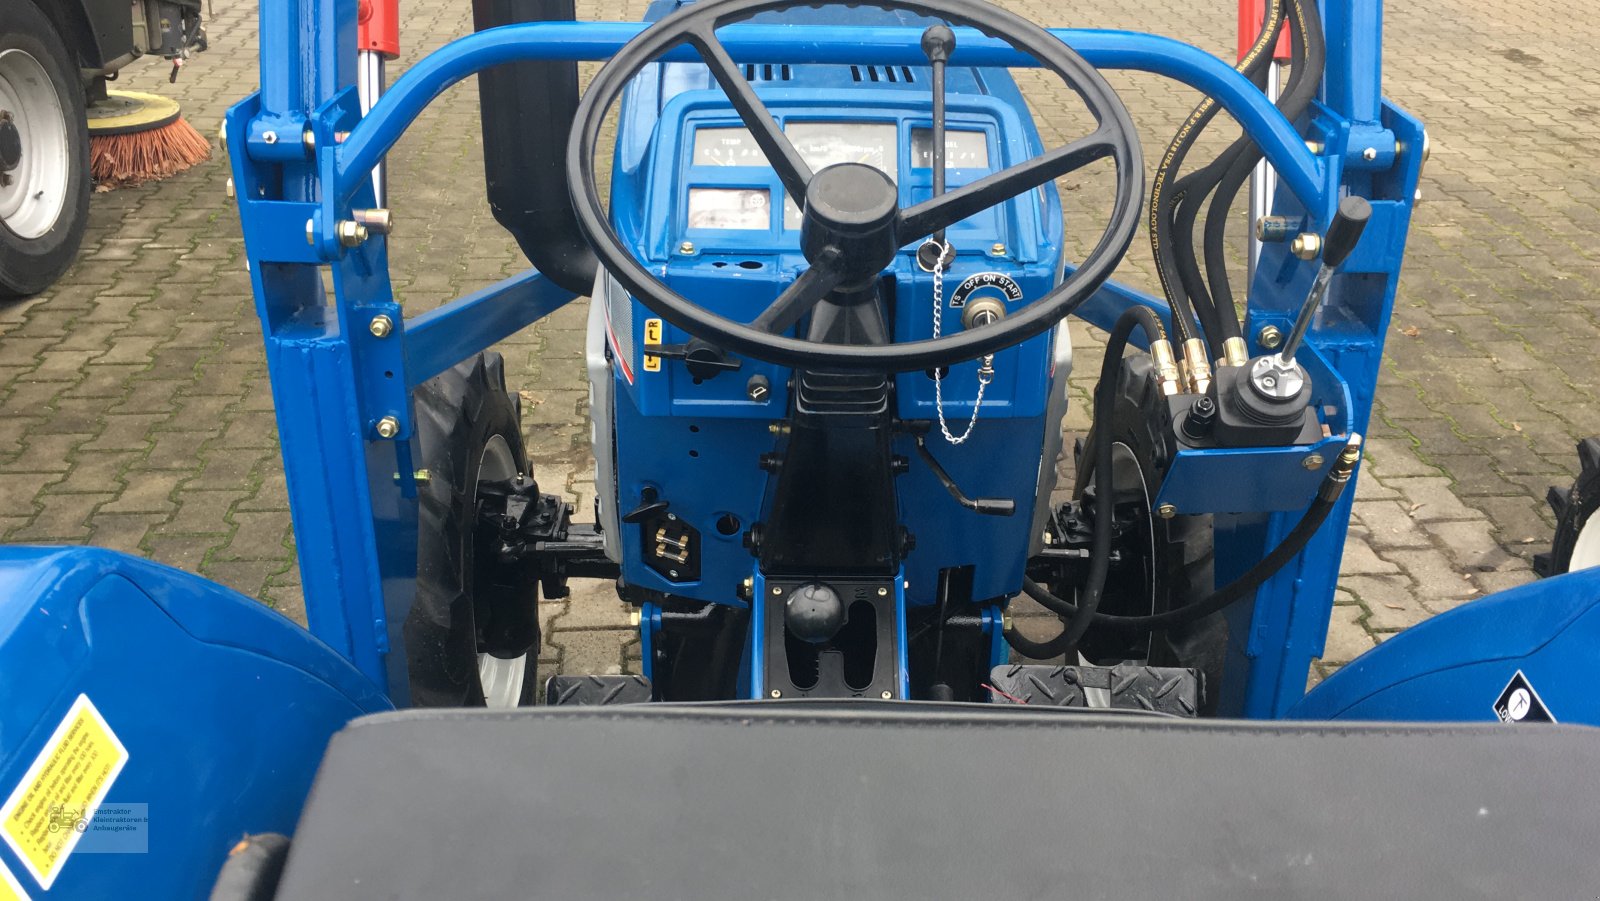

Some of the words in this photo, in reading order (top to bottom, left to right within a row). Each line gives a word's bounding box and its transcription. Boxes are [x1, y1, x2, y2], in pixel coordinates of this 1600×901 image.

[1161, 150, 1175, 172] USA
[1150, 170, 1166, 231] TECHNOLOGY
[1151, 232, 1159, 249] STD
[964, 276, 981, 290] OFF
[982, 274, 996, 282] ON
[998, 277, 1021, 298] START
